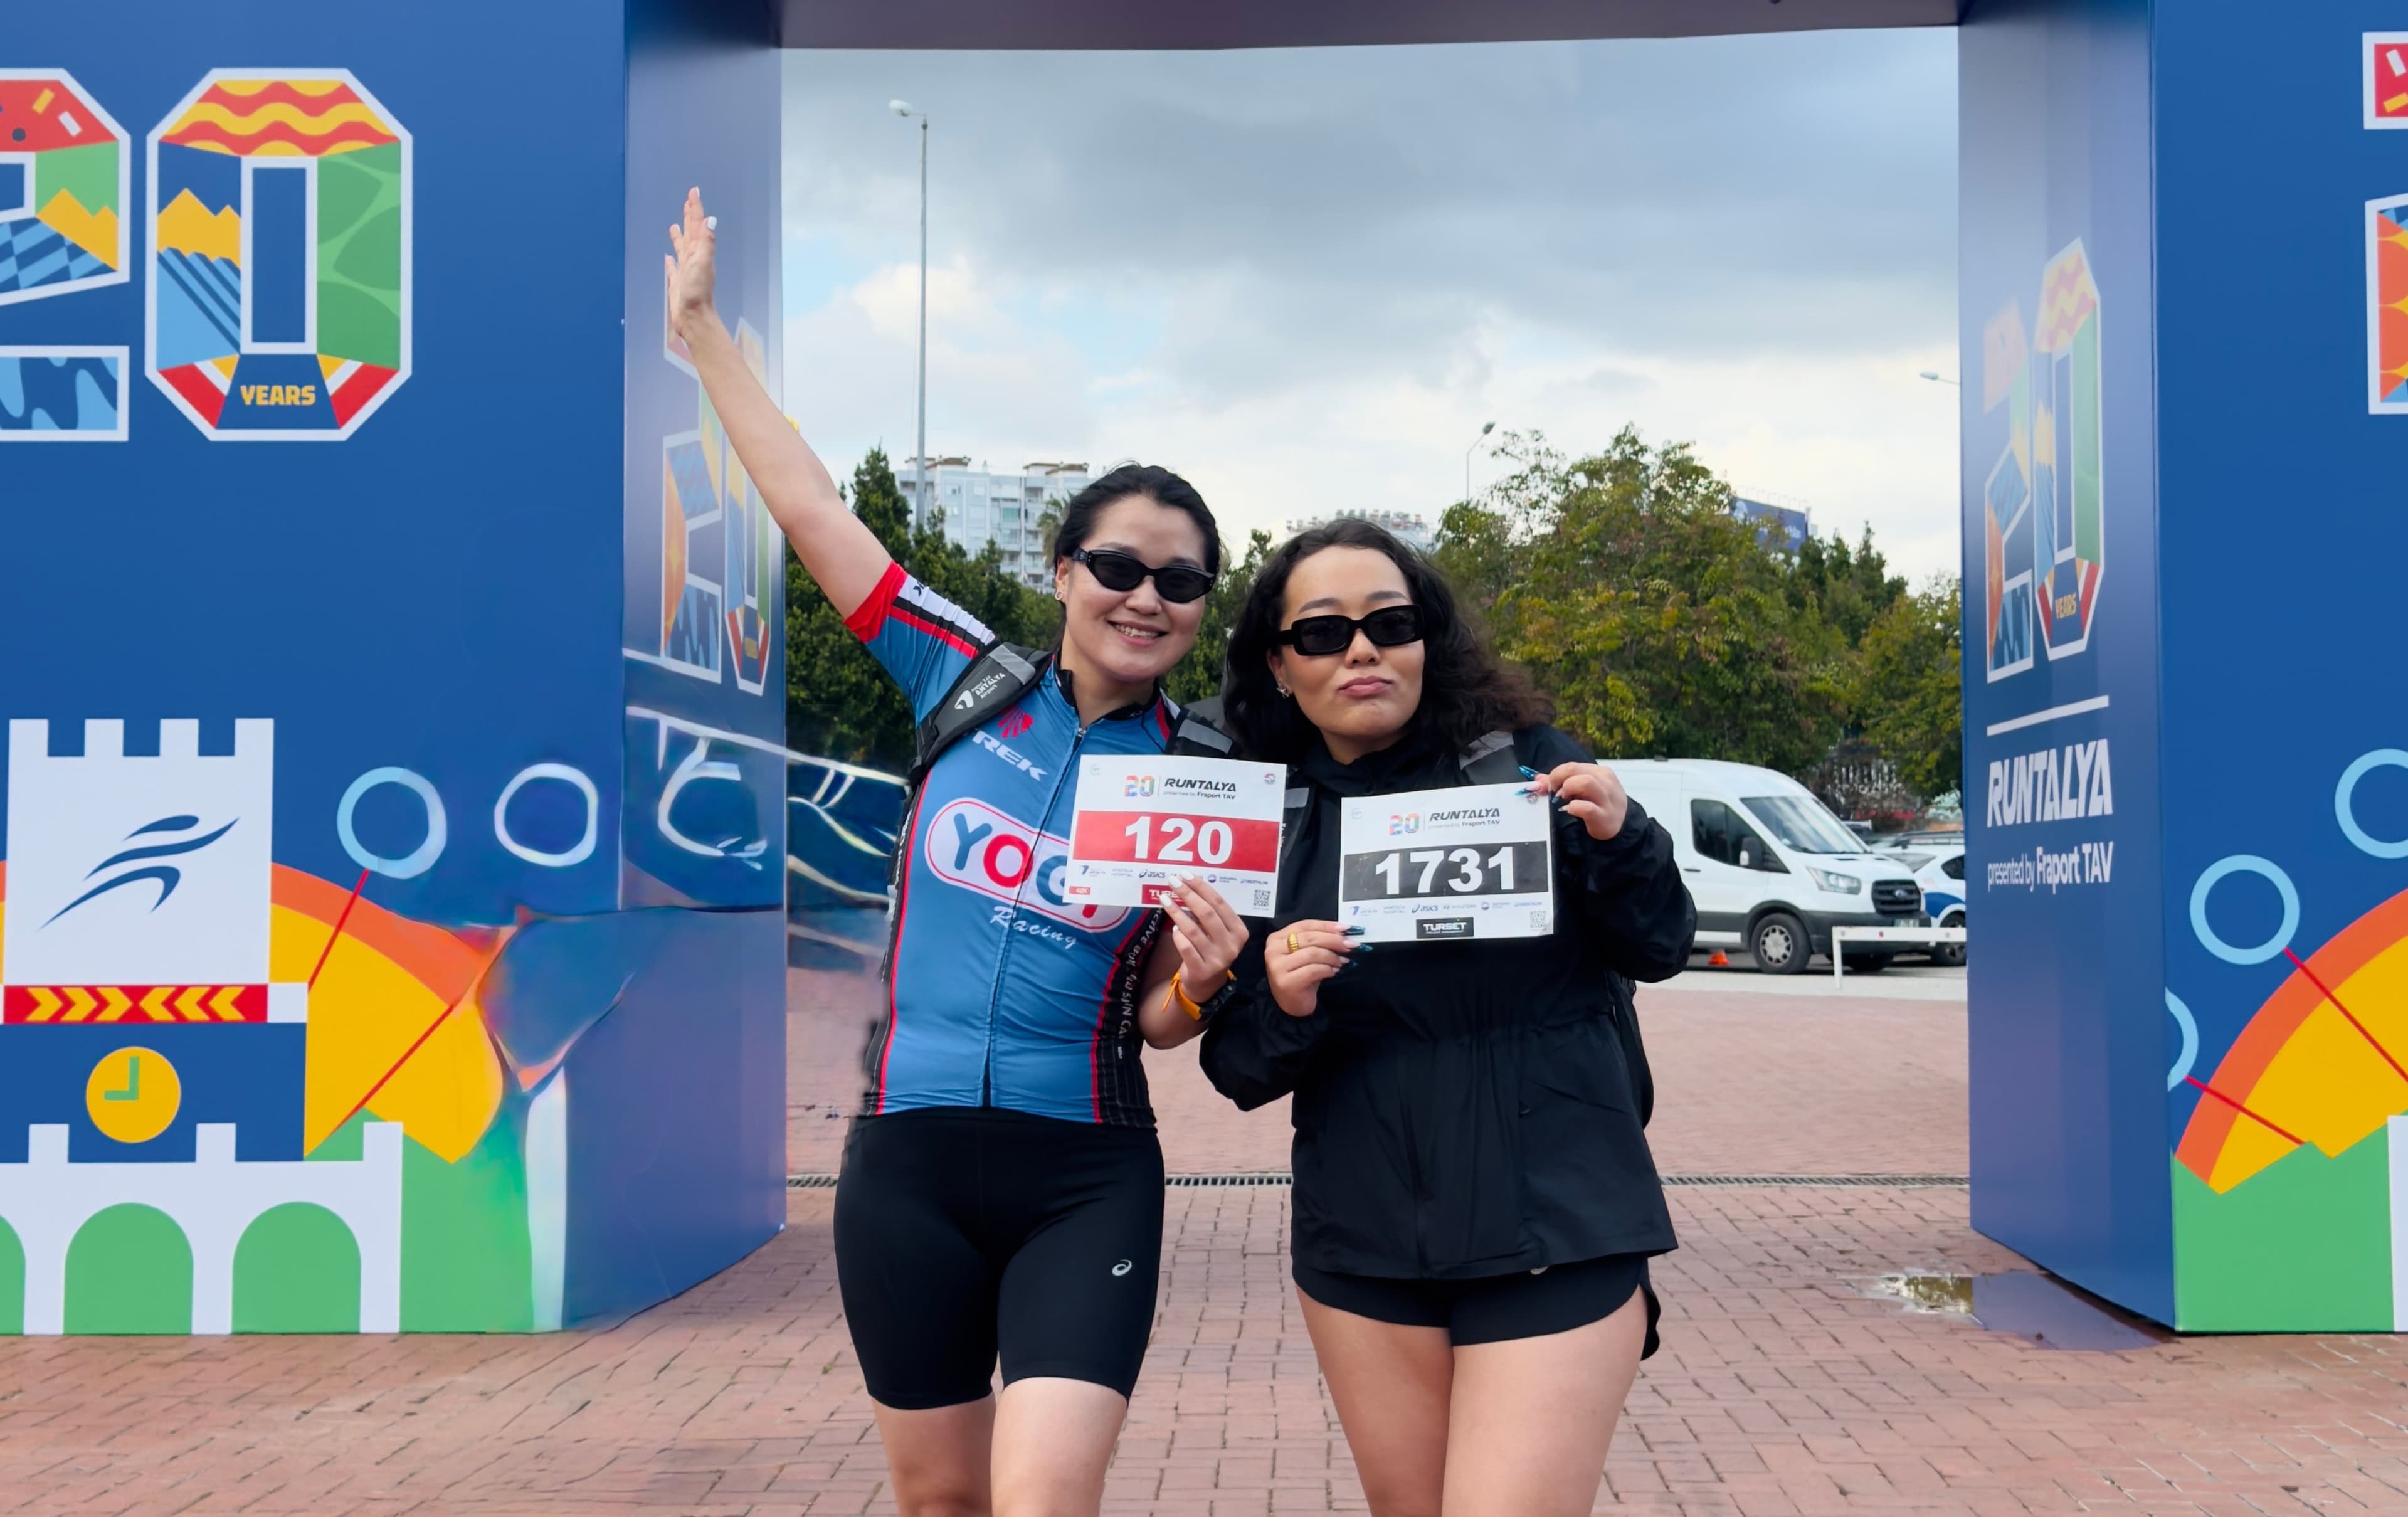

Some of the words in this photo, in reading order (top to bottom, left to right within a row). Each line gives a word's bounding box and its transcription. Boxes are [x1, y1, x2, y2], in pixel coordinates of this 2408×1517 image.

[240, 385, 315, 406] YEARS
[974, 672, 1006, 697] ANTALYA
[972, 730, 1048, 782] REK
[1124, 774, 1155, 798] 20
[1164, 778, 1237, 793] RUNTALYA
[1987, 739, 2113, 828] RUNTALYA
[1389, 813, 1420, 836] 20
[1429, 808, 1500, 822] RUNTALYA
[1124, 816, 1233, 865] 120
[1375, 846, 1514, 895] 1731
[1988, 853, 2024, 892] presented
[2025, 852, 2036, 892] by
[2037, 846, 2081, 895] Fraport
[2081, 841, 2114, 884] TAV
[990, 906, 1078, 949] Racing
[1423, 922, 1467, 931] TURSET
